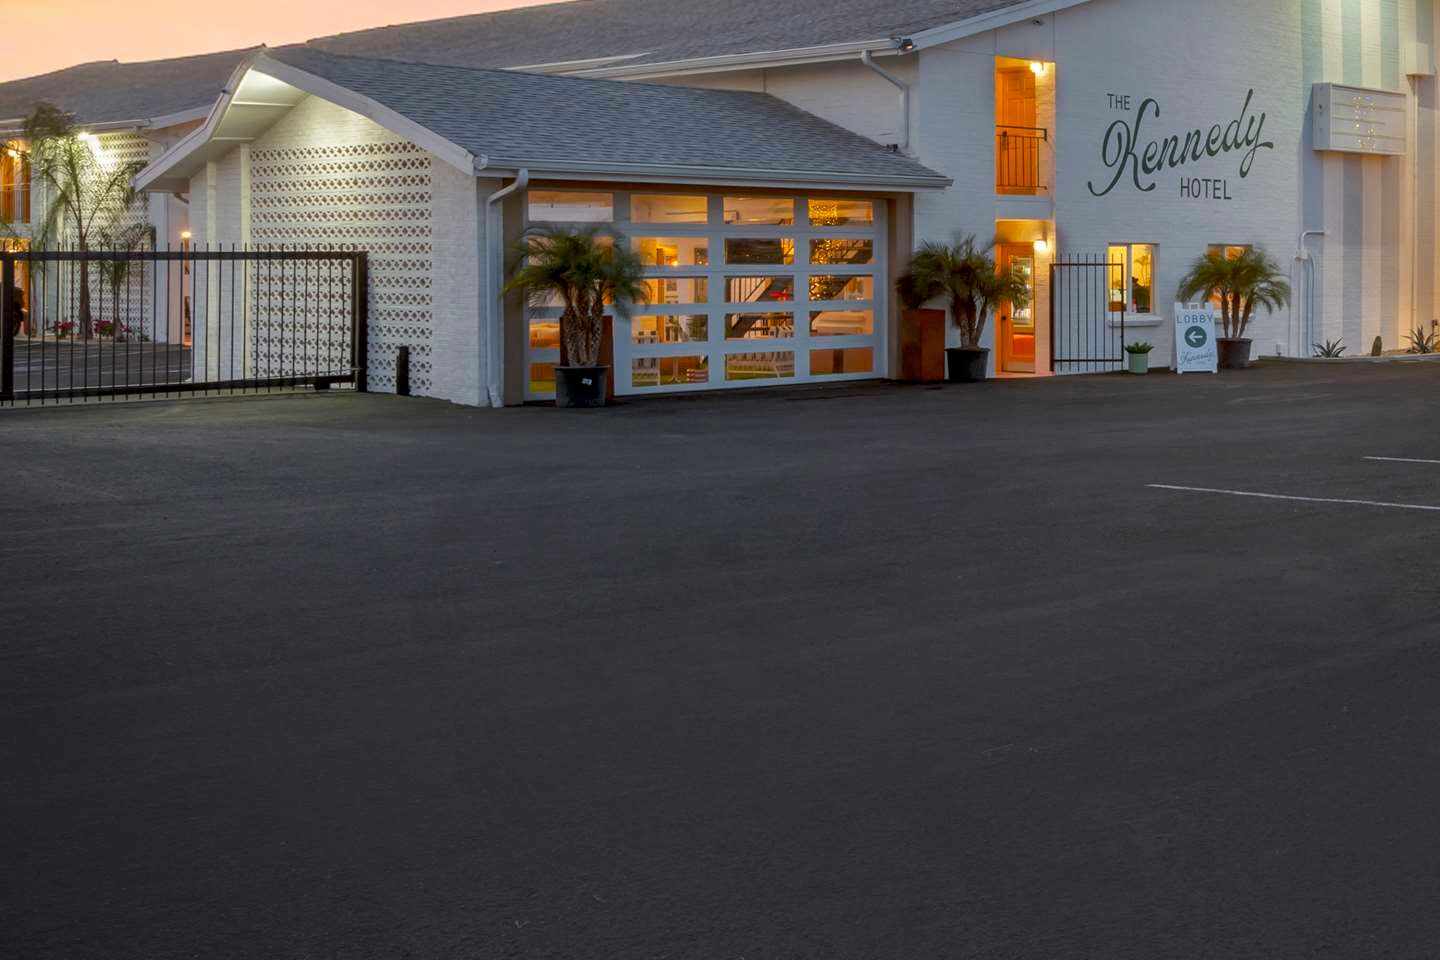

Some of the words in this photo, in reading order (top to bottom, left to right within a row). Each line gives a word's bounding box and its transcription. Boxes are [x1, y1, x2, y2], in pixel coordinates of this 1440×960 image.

[1106, 93, 1131, 111] THE
[1087, 88, 1274, 197] Kennedy
[1179, 176, 1233, 200] HOTEL
[1176, 313, 1213, 324] LOBBY
